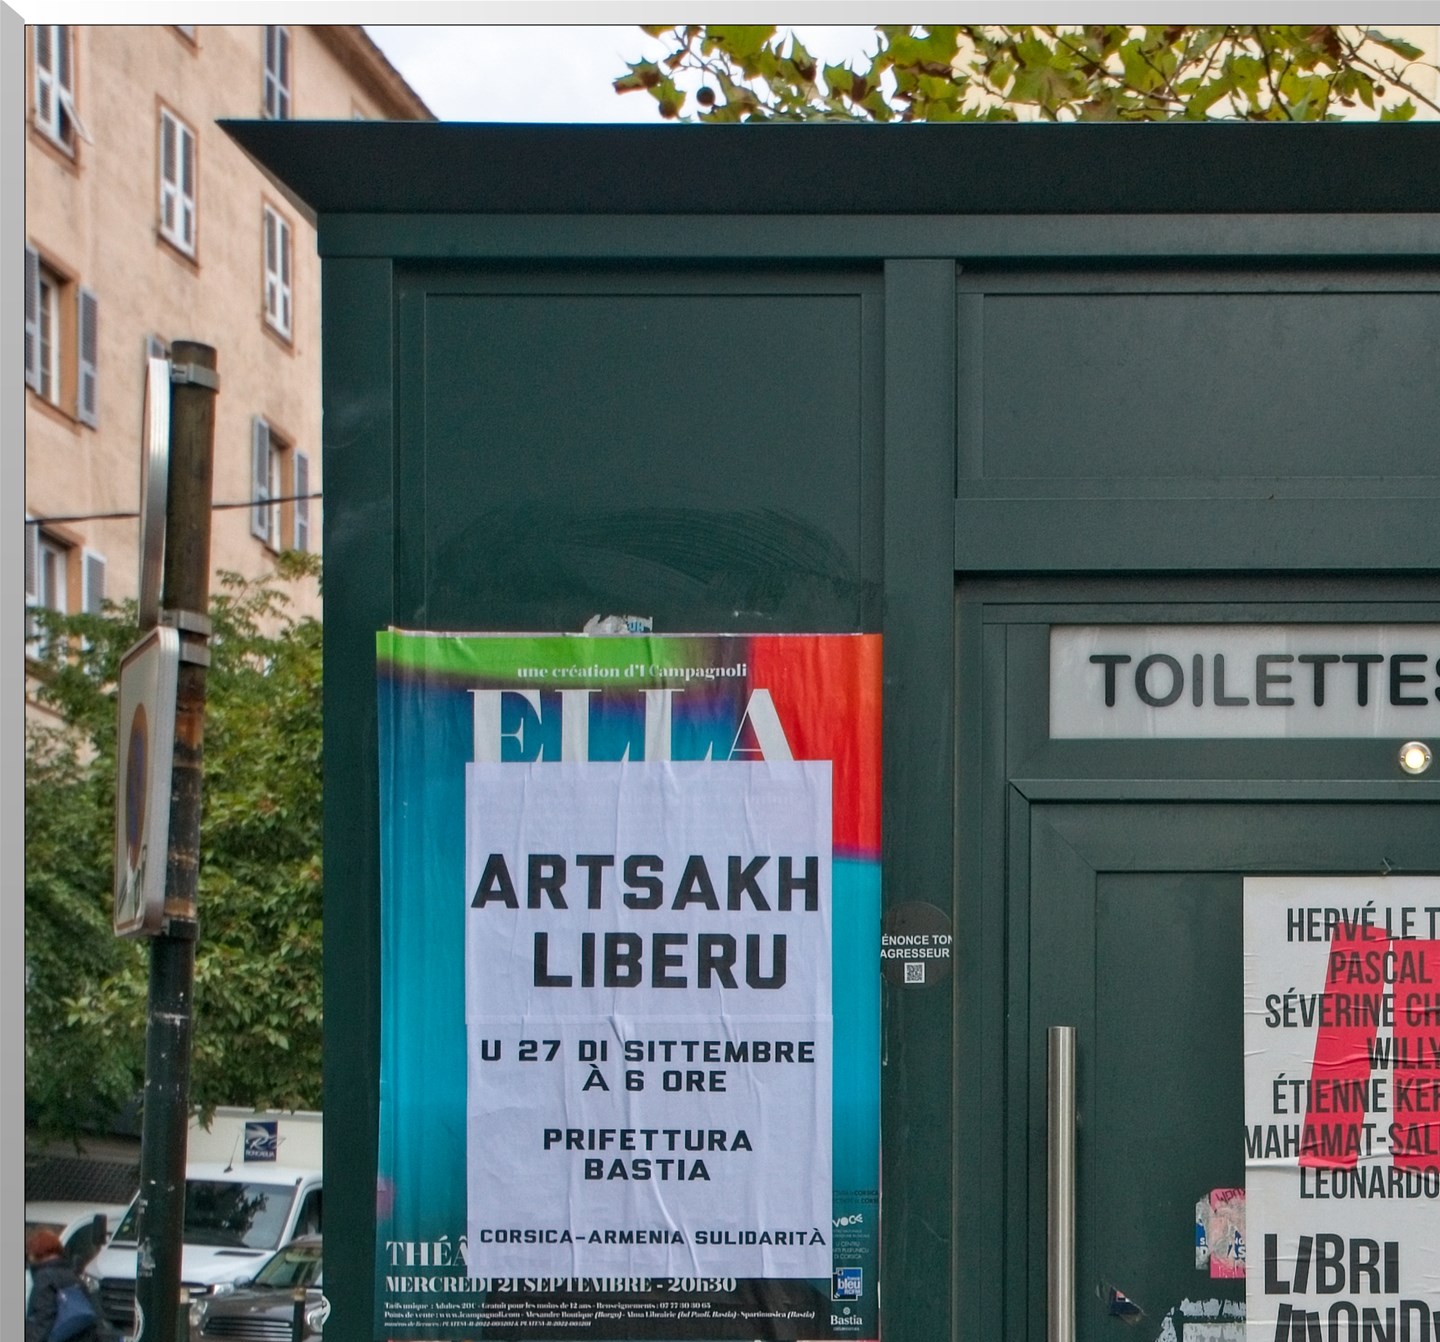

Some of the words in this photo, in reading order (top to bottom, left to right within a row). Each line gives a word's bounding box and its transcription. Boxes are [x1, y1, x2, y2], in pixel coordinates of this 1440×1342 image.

[517, 666, 548, 678] une
[552, 664, 620, 678] création
[649, 664, 747, 681] Campagnoli
[467, 688, 795, 762] ELLA
[471, 854, 819, 911] ARTSAKH
[1287, 900, 1376, 942] HERVÉ
[1386, 907, 1415, 941] LE
[534, 932, 788, 989] LIBERU
[880, 948, 950, 958] AGRESSEUR
[1331, 950, 1432, 984] PASCAL
[1265, 987, 1396, 1028] SÉVERINE
[481, 1039, 501, 1062] U
[518, 1039, 561, 1062] 27
[578, 1040, 608, 1063] DI
[623, 1040, 816, 1064] SITTEMBRE
[582, 1063, 610, 1091] À
[625, 1070, 645, 1092] 6
[663, 1070, 727, 1092] ORE
[1273, 1073, 1387, 1114] ÉTIENNE
[543, 1129, 753, 1152] PRIFETTURA
[584, 1159, 711, 1181] BASTIA
[1300, 1165, 1440, 1199] LEONARDO
[695, 1228, 826, 1246] SULIDARITÀ
[1264, 1233, 1399, 1295] LIBRI
